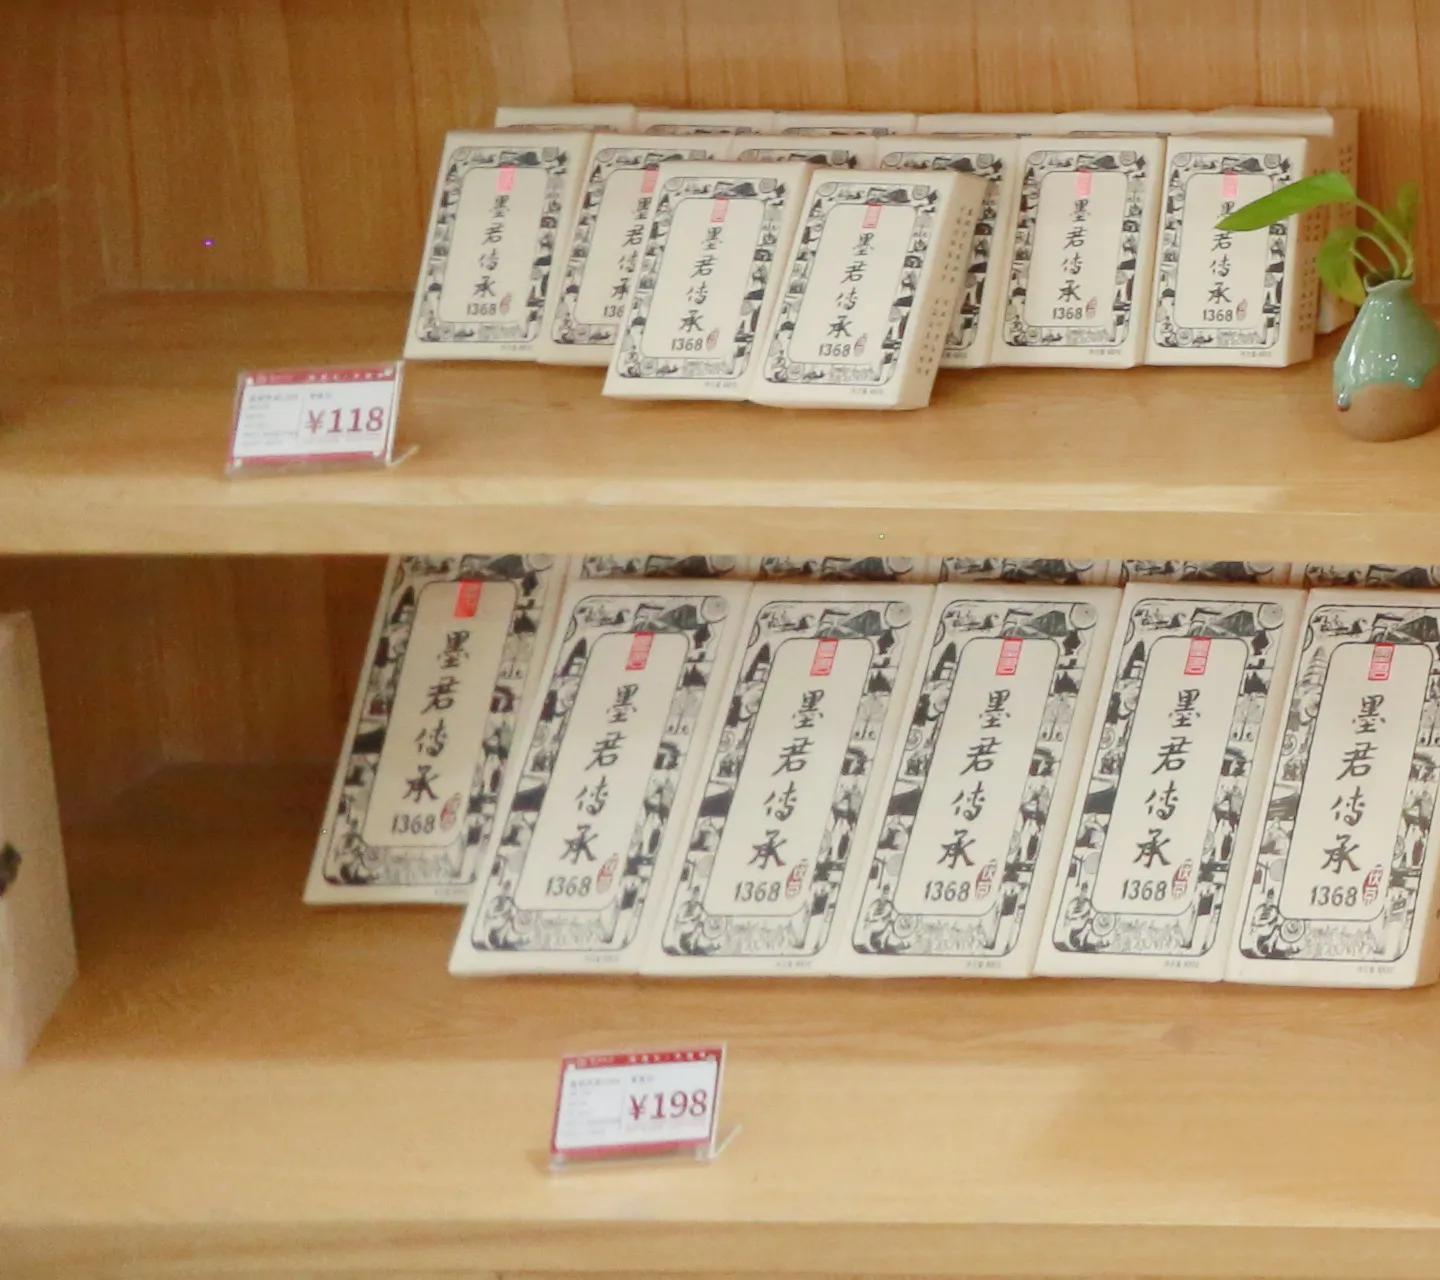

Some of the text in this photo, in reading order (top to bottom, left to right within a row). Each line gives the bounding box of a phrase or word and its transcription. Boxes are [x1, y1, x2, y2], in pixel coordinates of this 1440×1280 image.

[466, 302, 496, 315] 1368
[603, 304, 624, 317] 136
[1051, 306, 1083, 320] 1368
[1201, 307, 1233, 321] 1368
[670, 338, 703, 352] 1368
[817, 344, 850, 357] 1368
[306, 406, 384, 435] ¥118
[403, 630, 470, 803] 墨君传承
[560, 683, 640, 866] 墨君传承
[748, 690, 826, 870] 墨君传承
[936, 688, 1012, 869] 墨君传承
[1132, 688, 1201, 869] 墨君传承
[1320, 694, 1387, 875] 墨君传承
[391, 814, 435, 835] 1368
[546, 876, 591, 897] 1368
[734, 881, 780, 902] 1368
[924, 880, 970, 902] 1368
[1121, 880, 1167, 902] 1368
[1309, 885, 1358, 907] 1368
[629, 1089, 708, 1120] ¥198
